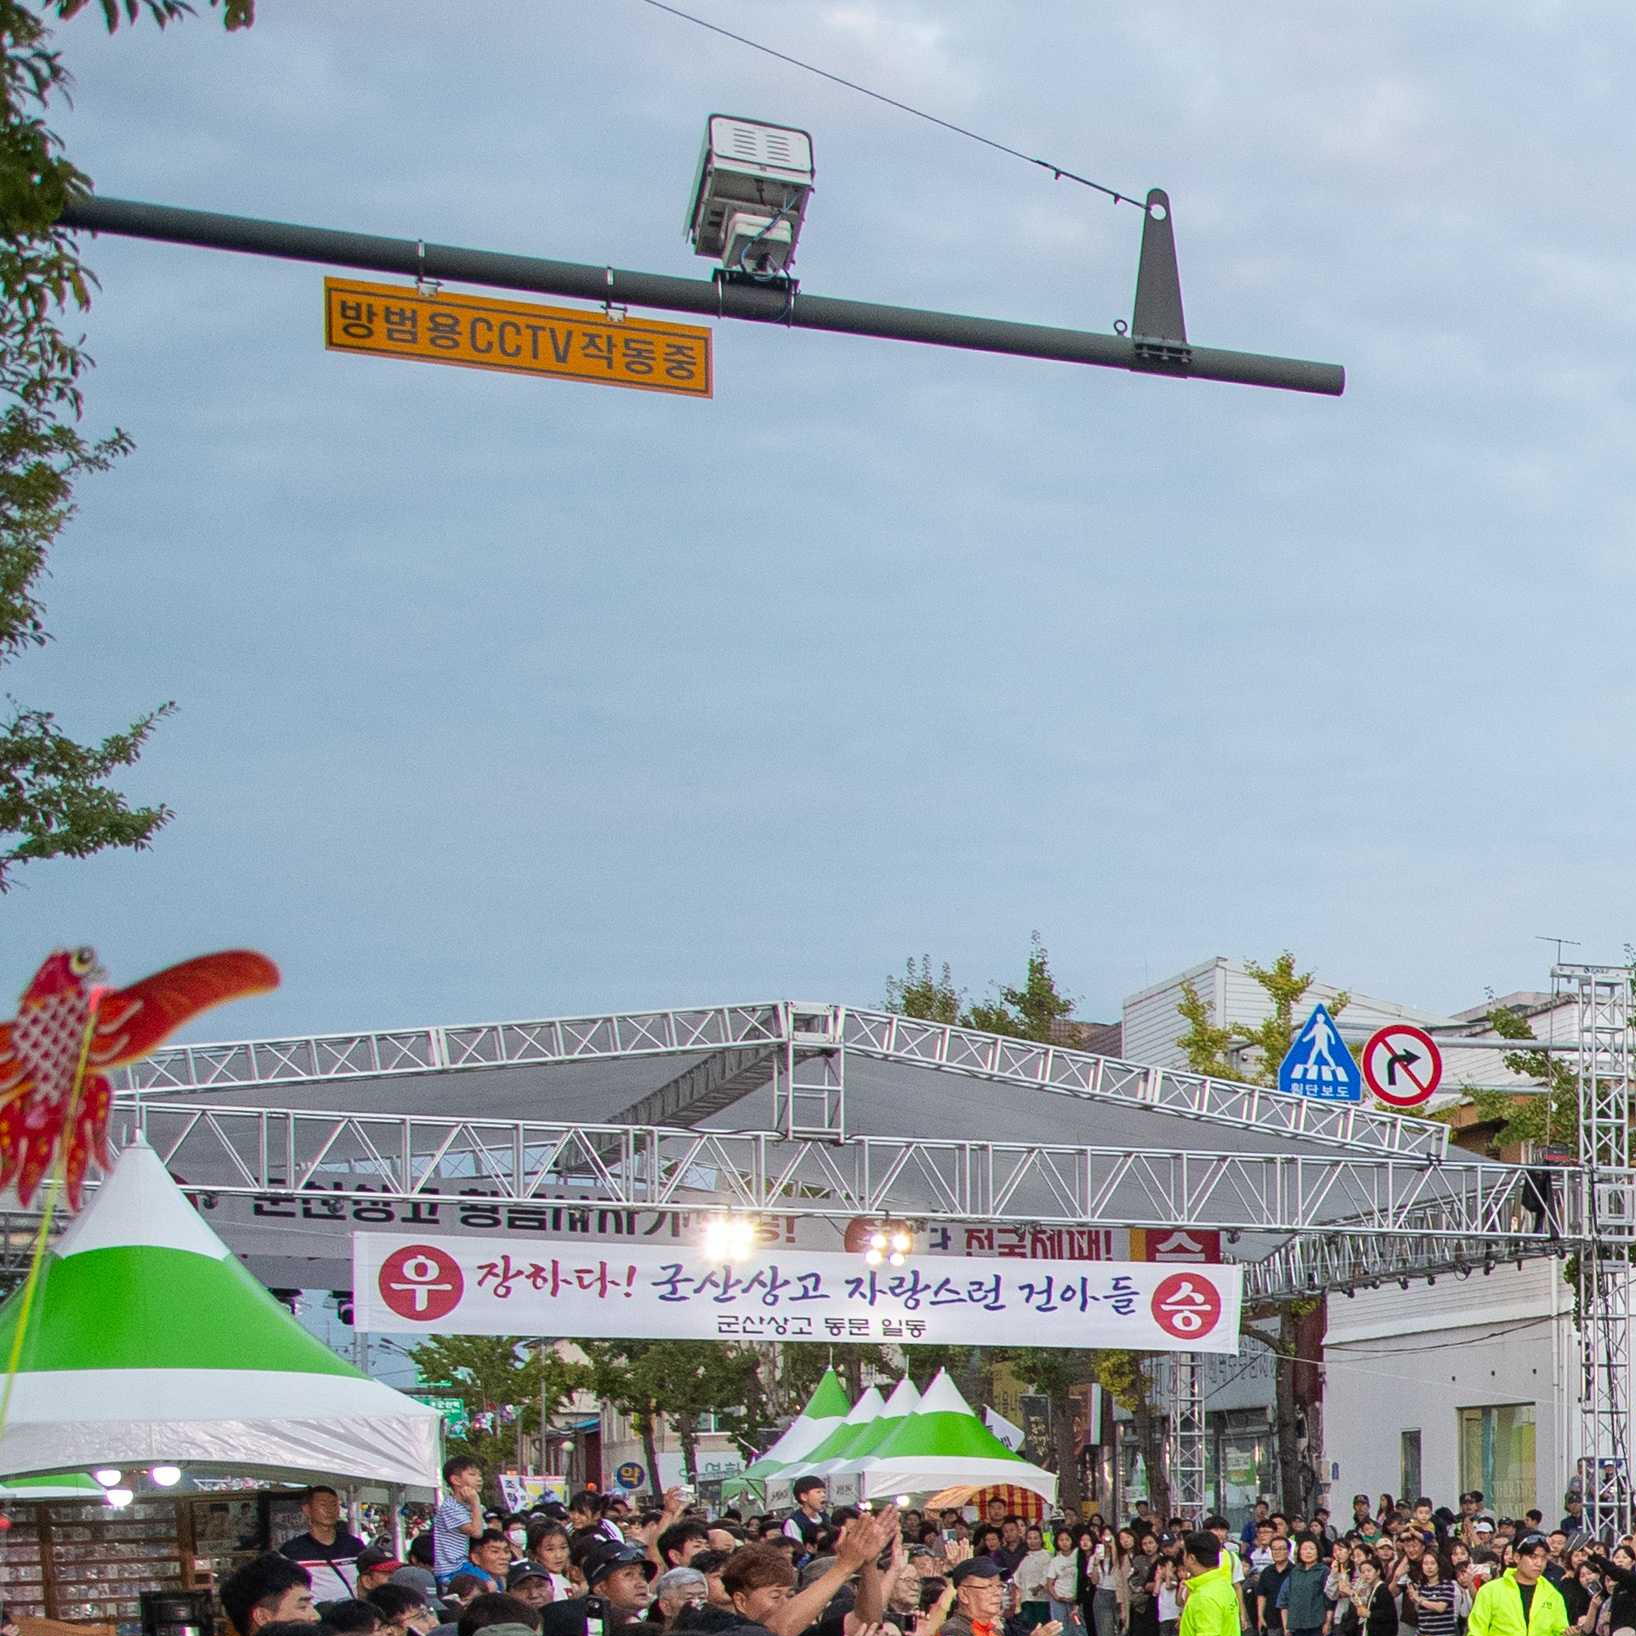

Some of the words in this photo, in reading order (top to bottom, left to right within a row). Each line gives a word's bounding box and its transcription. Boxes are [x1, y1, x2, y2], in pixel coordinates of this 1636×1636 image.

[338, 299, 698, 382] 방범용CCTV작동중
[1290, 1082, 1350, 1098] 횡단보도
[390, 1255, 453, 1311] 우
[477, 1254, 637, 1299] 장하다!
[651, 1263, 831, 1307] 군산상고
[844, 1270, 1006, 1312] 자랑스런
[1018, 1275, 1141, 1316] 건아들
[1160, 1281, 1212, 1329] 승
[716, 1314, 813, 1336] 군산상고
[824, 1317, 871, 1336] 동문
[881, 1318, 927, 1338] 일동
